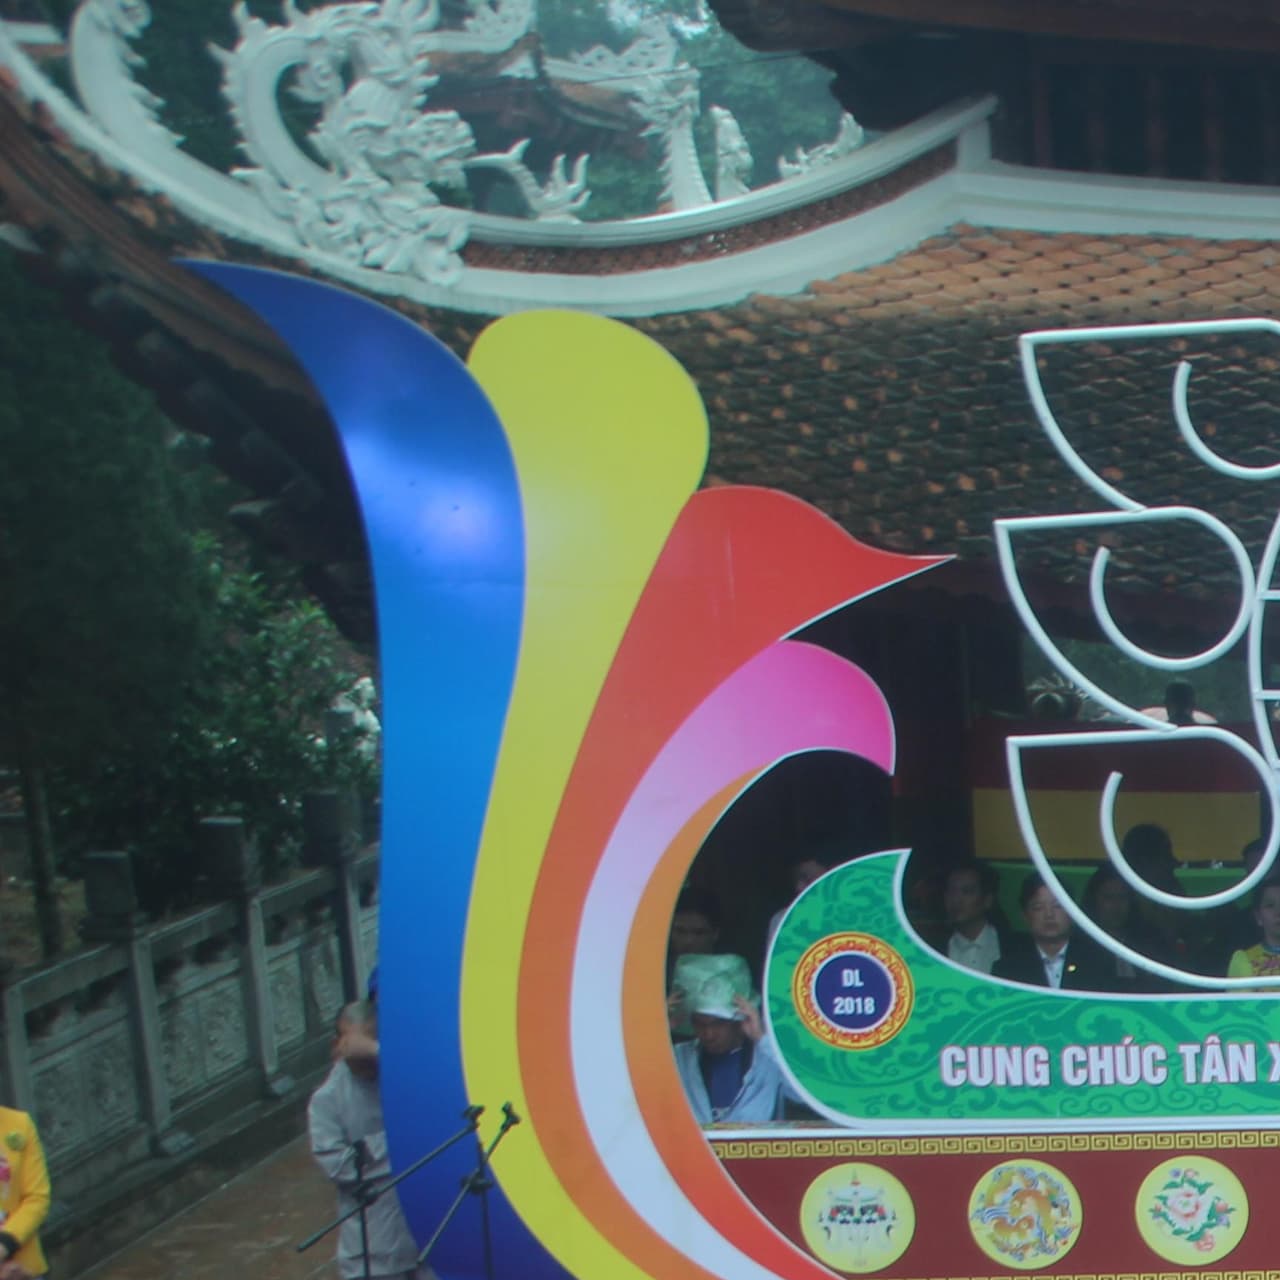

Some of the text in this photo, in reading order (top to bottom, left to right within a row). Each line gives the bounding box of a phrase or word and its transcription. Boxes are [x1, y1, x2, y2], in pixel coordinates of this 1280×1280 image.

[833, 996, 875, 1015] 2018
[940, 1045, 1050, 1087] CUNG
[1061, 1036, 1168, 1086] CHÚC
[1179, 1035, 1256, 1084] TÂN
